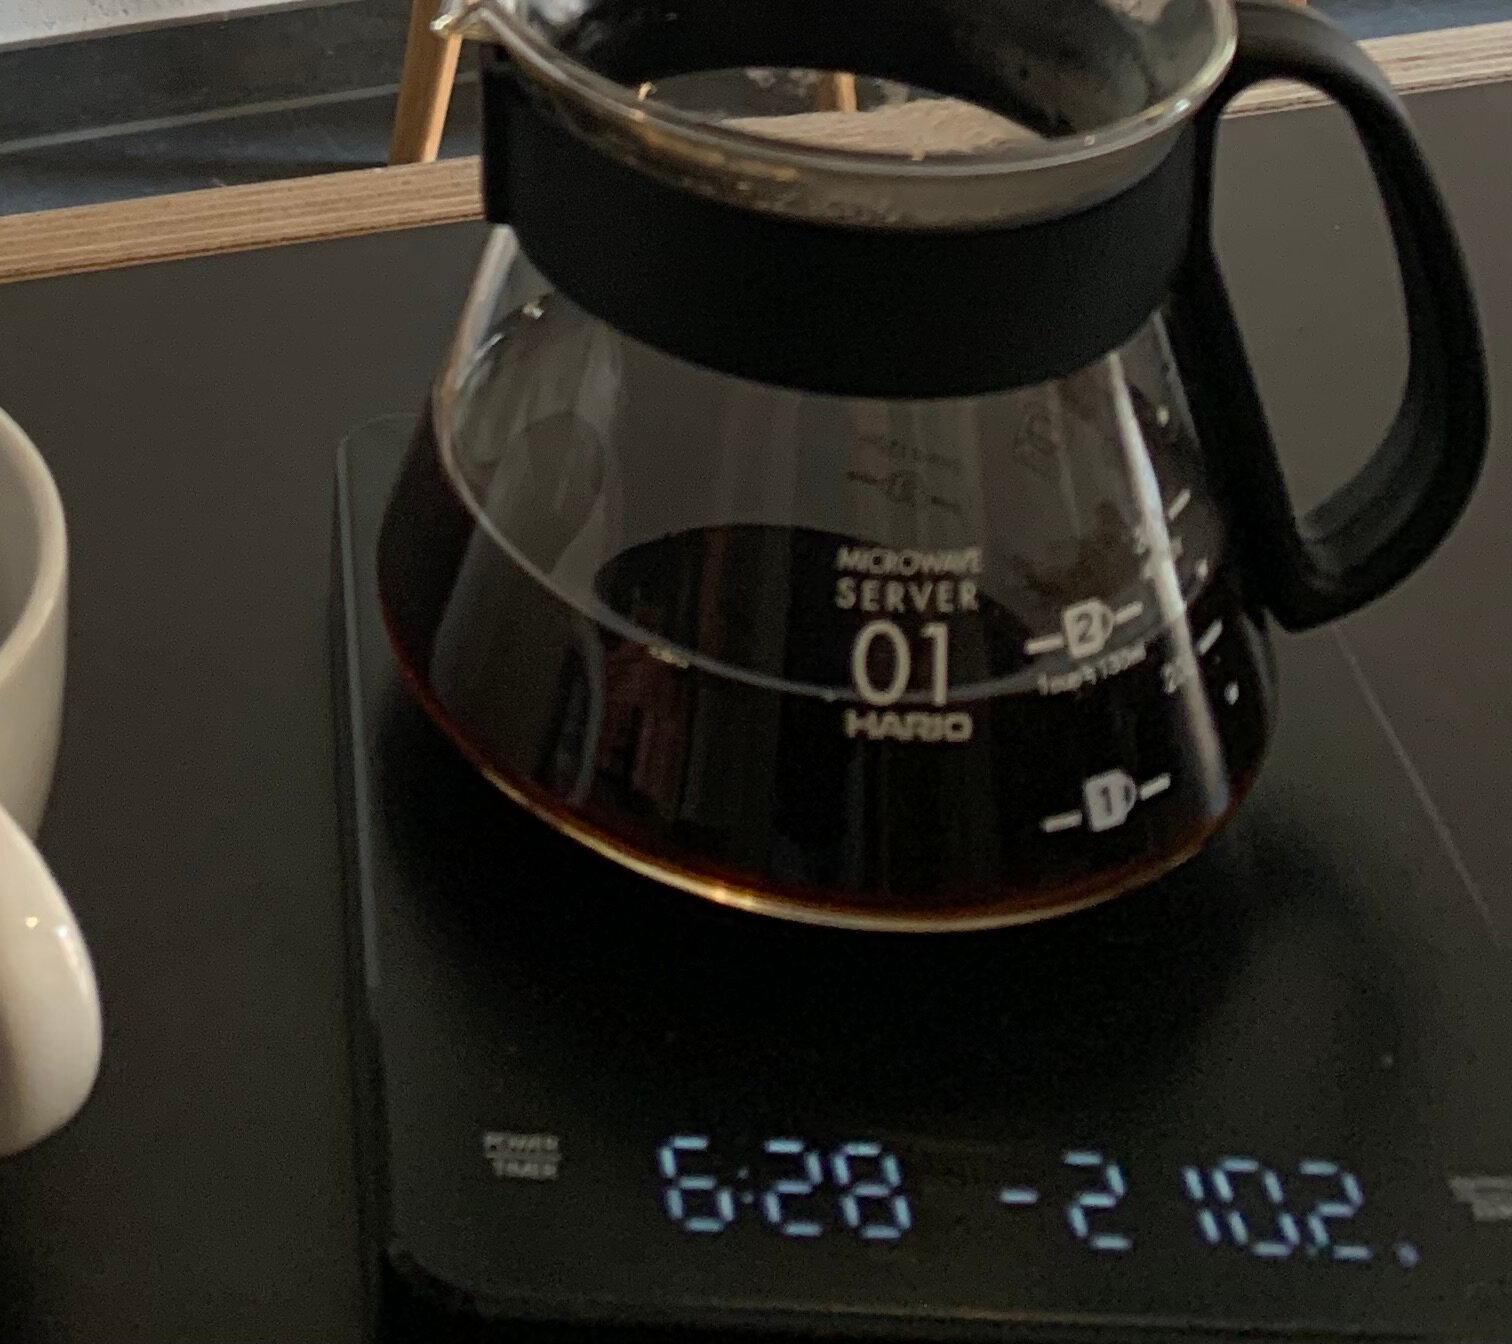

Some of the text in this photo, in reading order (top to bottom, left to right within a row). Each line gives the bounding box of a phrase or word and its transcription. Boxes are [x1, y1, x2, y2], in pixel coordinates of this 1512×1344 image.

[835, 576, 980, 612] SERVER
[851, 619, 950, 706] 01
[842, 709, 973, 743] HARIO
[658, 1135, 912, 1240] 6:28
